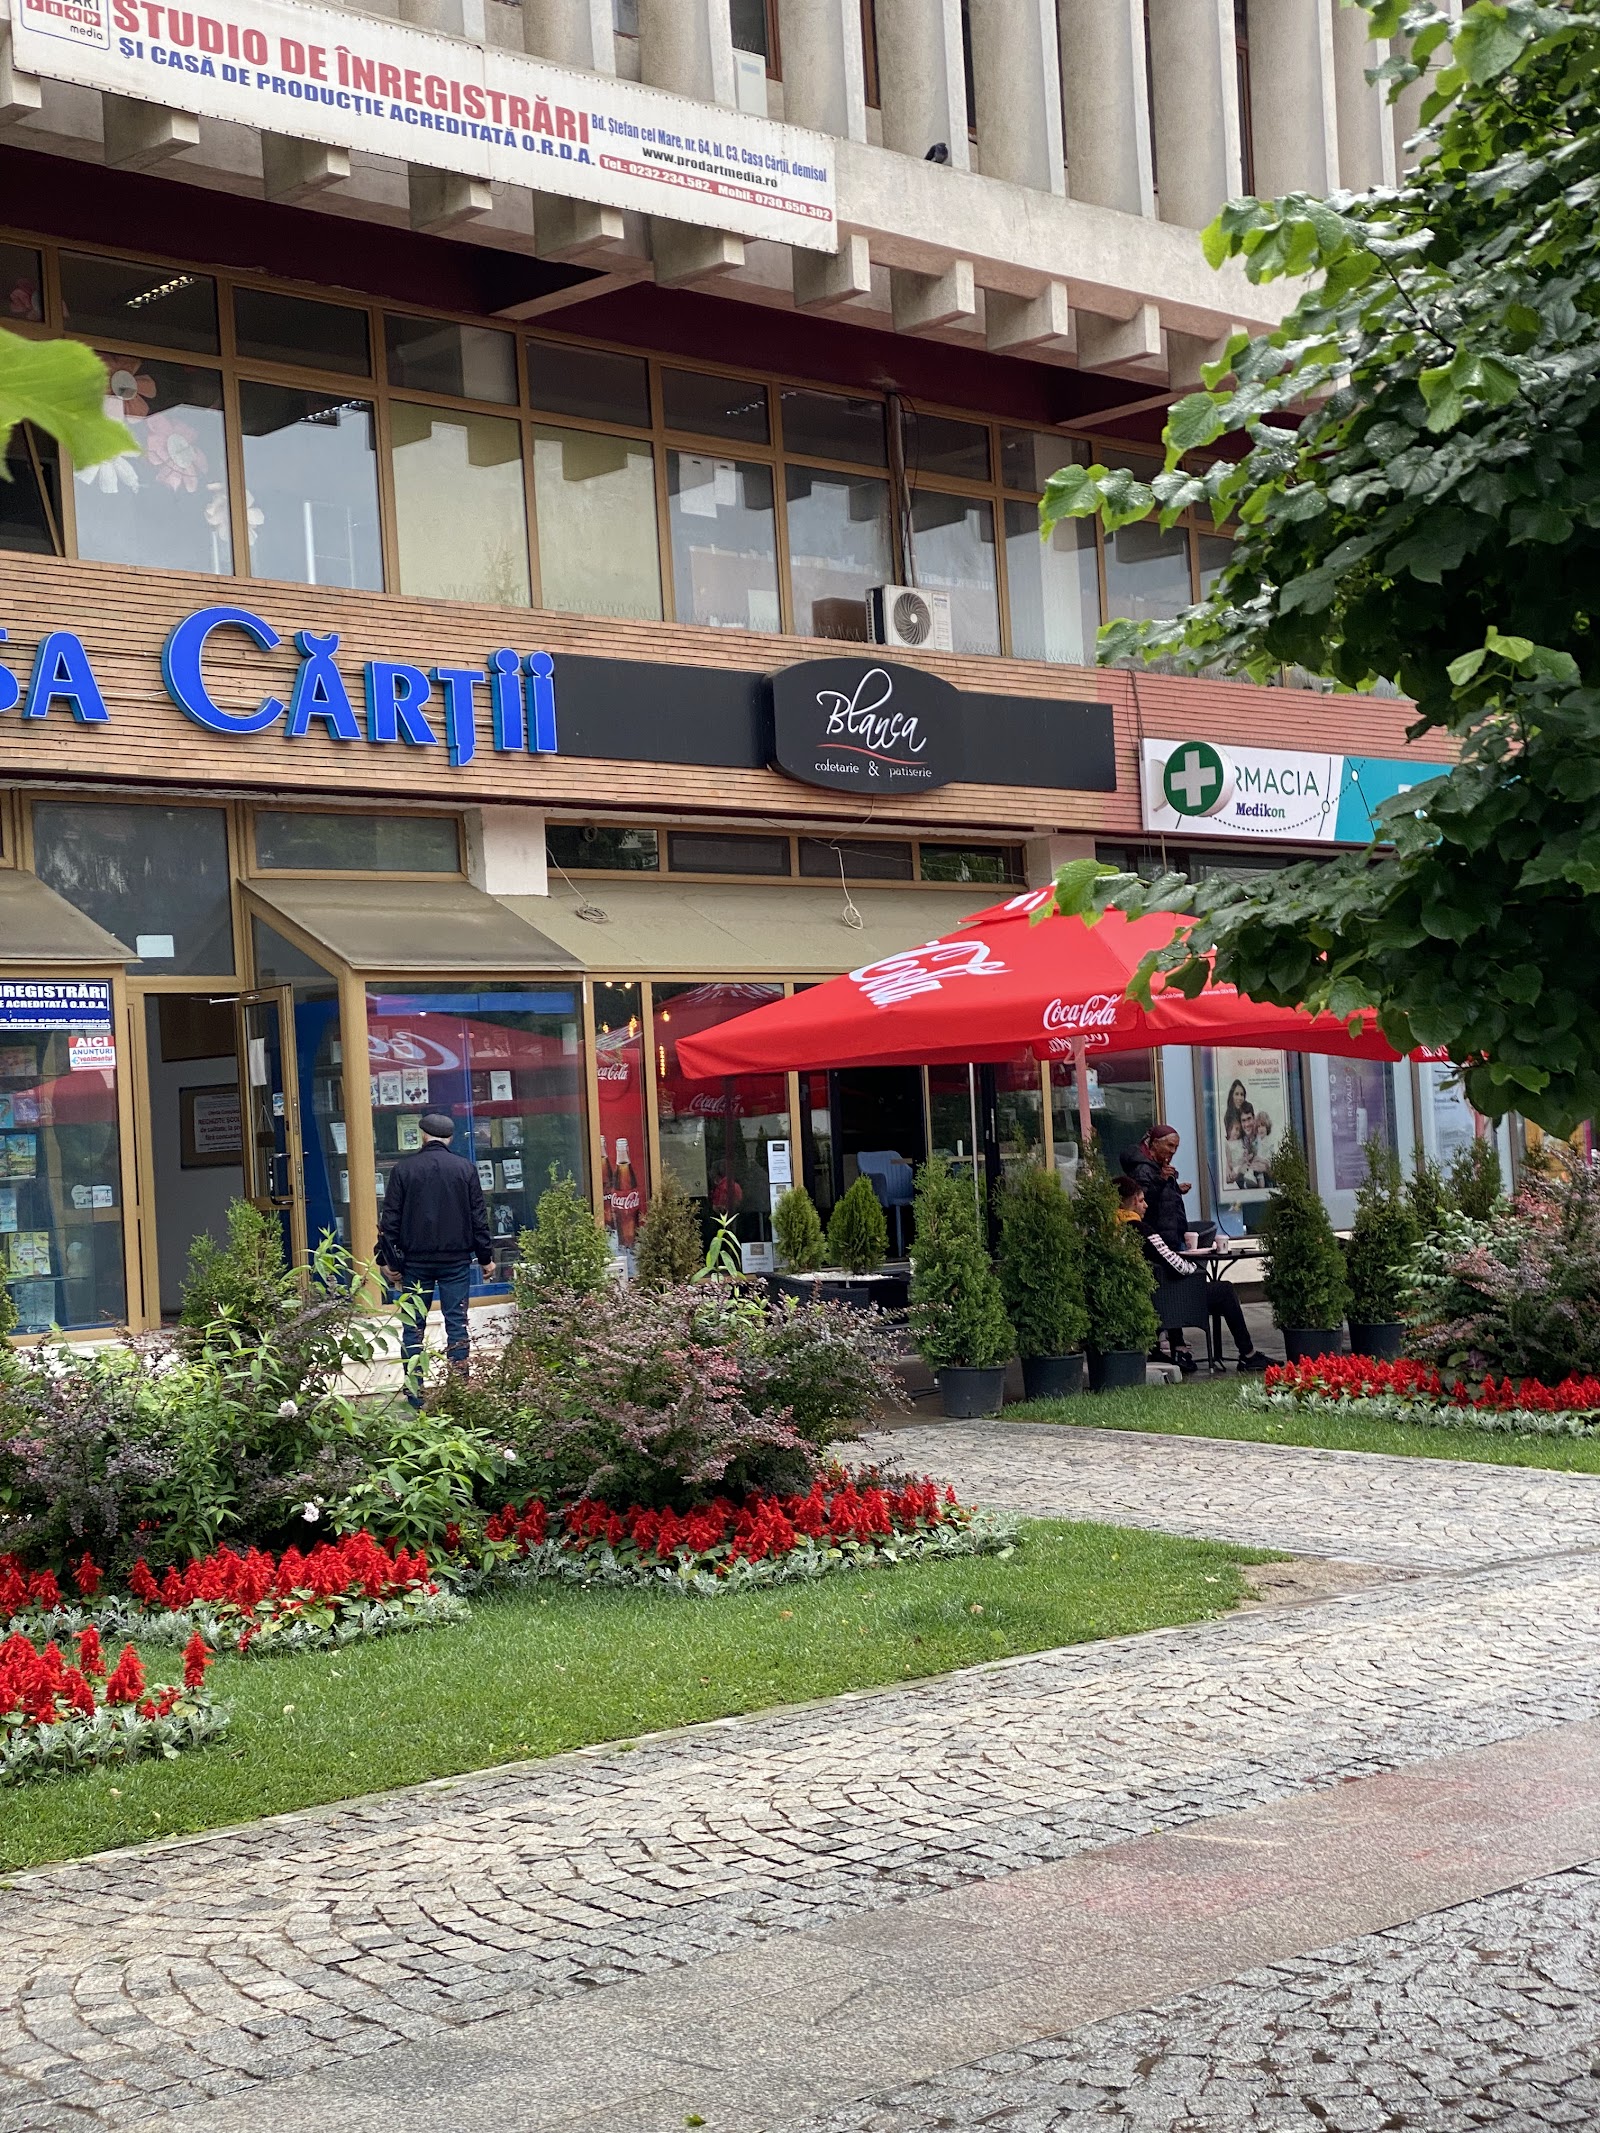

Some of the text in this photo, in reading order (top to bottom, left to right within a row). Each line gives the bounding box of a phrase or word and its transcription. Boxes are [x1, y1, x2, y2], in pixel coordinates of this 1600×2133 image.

[70, 25, 103, 40] media
[113, 0, 590, 145] STUDIO DE ÎNREGISTRĂRI
[151, 46, 216, 78] CASĂ
[222, 63, 251, 87] DE
[257, 72, 384, 118] PRODUCȚIE
[390, 104, 517, 149] ACREDITATĂ
[522, 134, 596, 166] O.R.D.A.
[591, 113, 607, 131] Bd.
[641, 127, 656, 143] cel
[685, 137, 697, 152] nr.
[698, 138, 712, 157] 64,
[726, 144, 740, 163] C3,
[741, 148, 764, 168] Casa
[792, 161, 827, 182] demisol
[642, 147, 778, 188] www.prodartmedia.ro
[718, 184, 754, 203] Mobil:
[755, 193, 831, 220] 0730.650.302
[868, 760, 880, 777] &
[889, 766, 932, 782] patiserie
[1234, 765, 1319, 796] RMACIA
[1236, 802, 1286, 819] Medikon
[1043, 994, 1122, 1031] Coca-Cola
[75, 1037, 109, 1047] AICI
